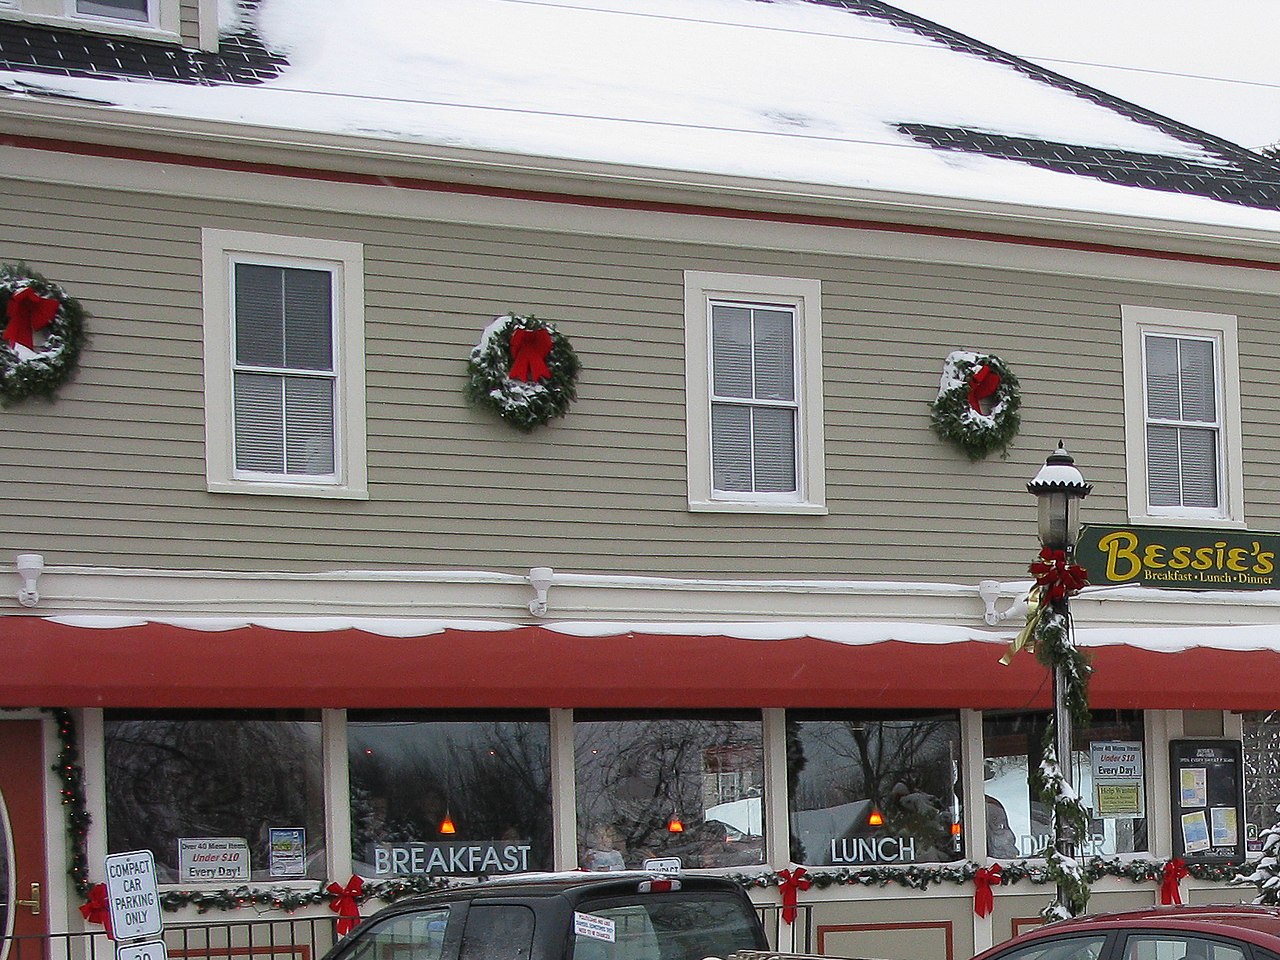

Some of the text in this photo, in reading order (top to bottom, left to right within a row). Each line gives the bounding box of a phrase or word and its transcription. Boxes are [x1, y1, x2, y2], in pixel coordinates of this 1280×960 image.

[1144, 569, 1273, 585] Breakfast Lunch Dinner
[1098, 765, 1136, 776] Every Day!
[192, 853, 220, 862] Under
[831, 837, 915, 862] LUNCH
[374, 845, 531, 875] BREAKFAST
[109, 859, 150, 878] COMPACT
[189, 866, 241, 878] Every Day!
[123, 878, 142, 893] CAR
[115, 893, 154, 911] PARKING
[125, 910, 148, 926] ONLY
